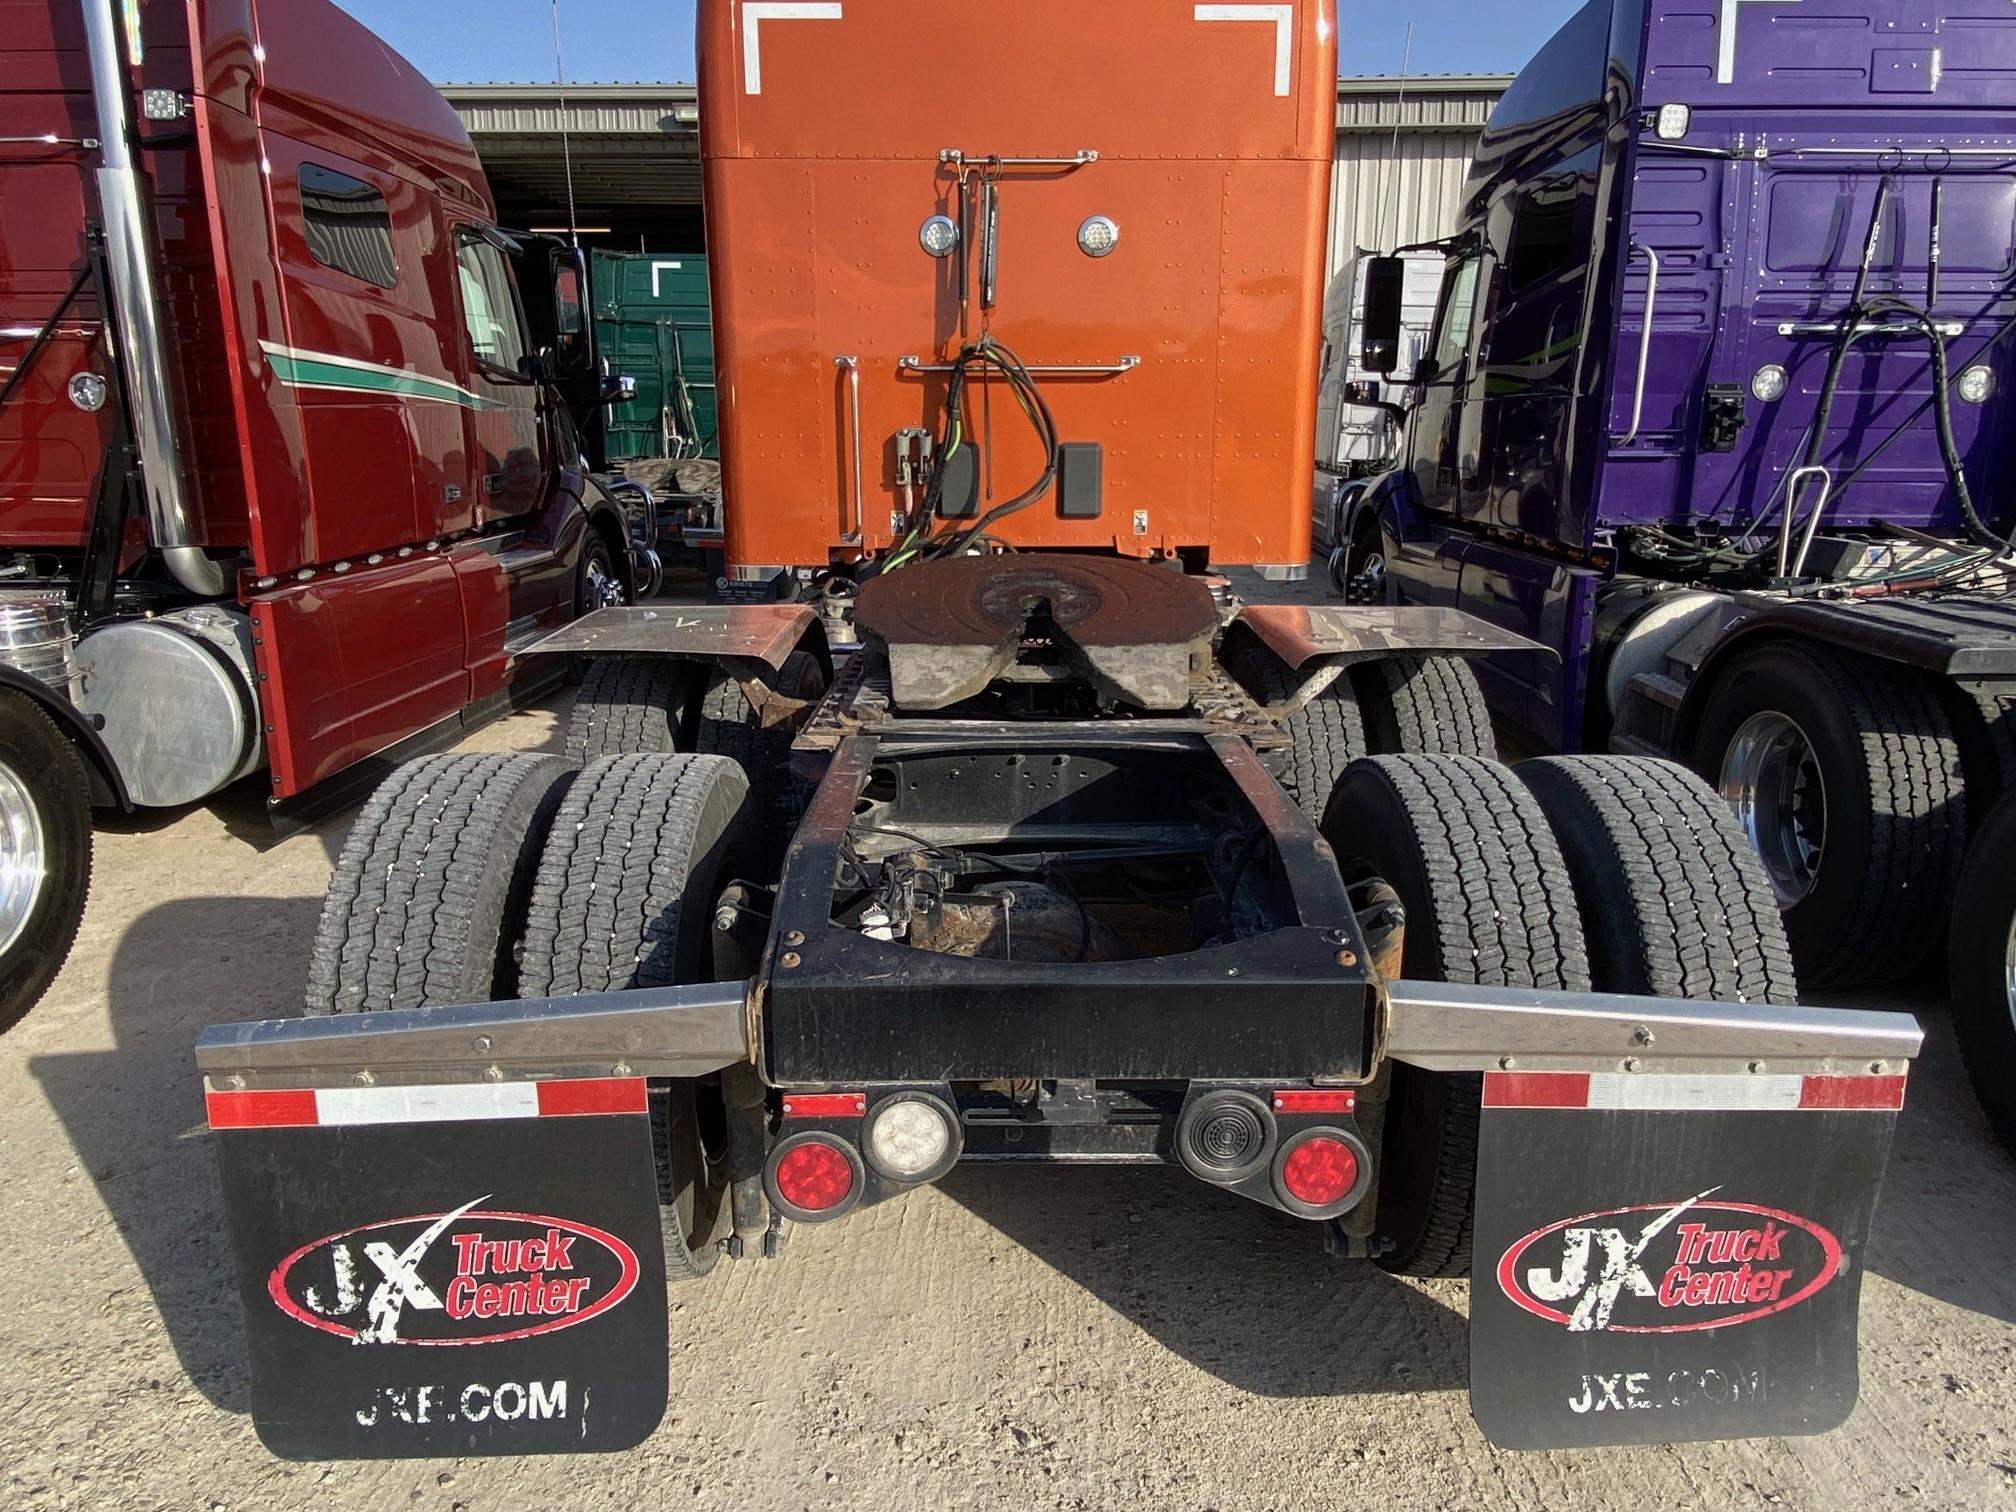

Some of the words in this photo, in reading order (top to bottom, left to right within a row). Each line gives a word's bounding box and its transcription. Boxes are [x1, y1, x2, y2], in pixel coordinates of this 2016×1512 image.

[452, 1228, 577, 1276] Truck
[1676, 1222, 1788, 1264] Truck
[446, 1272, 590, 1320] Center
[1659, 1265, 1794, 1308] Center
